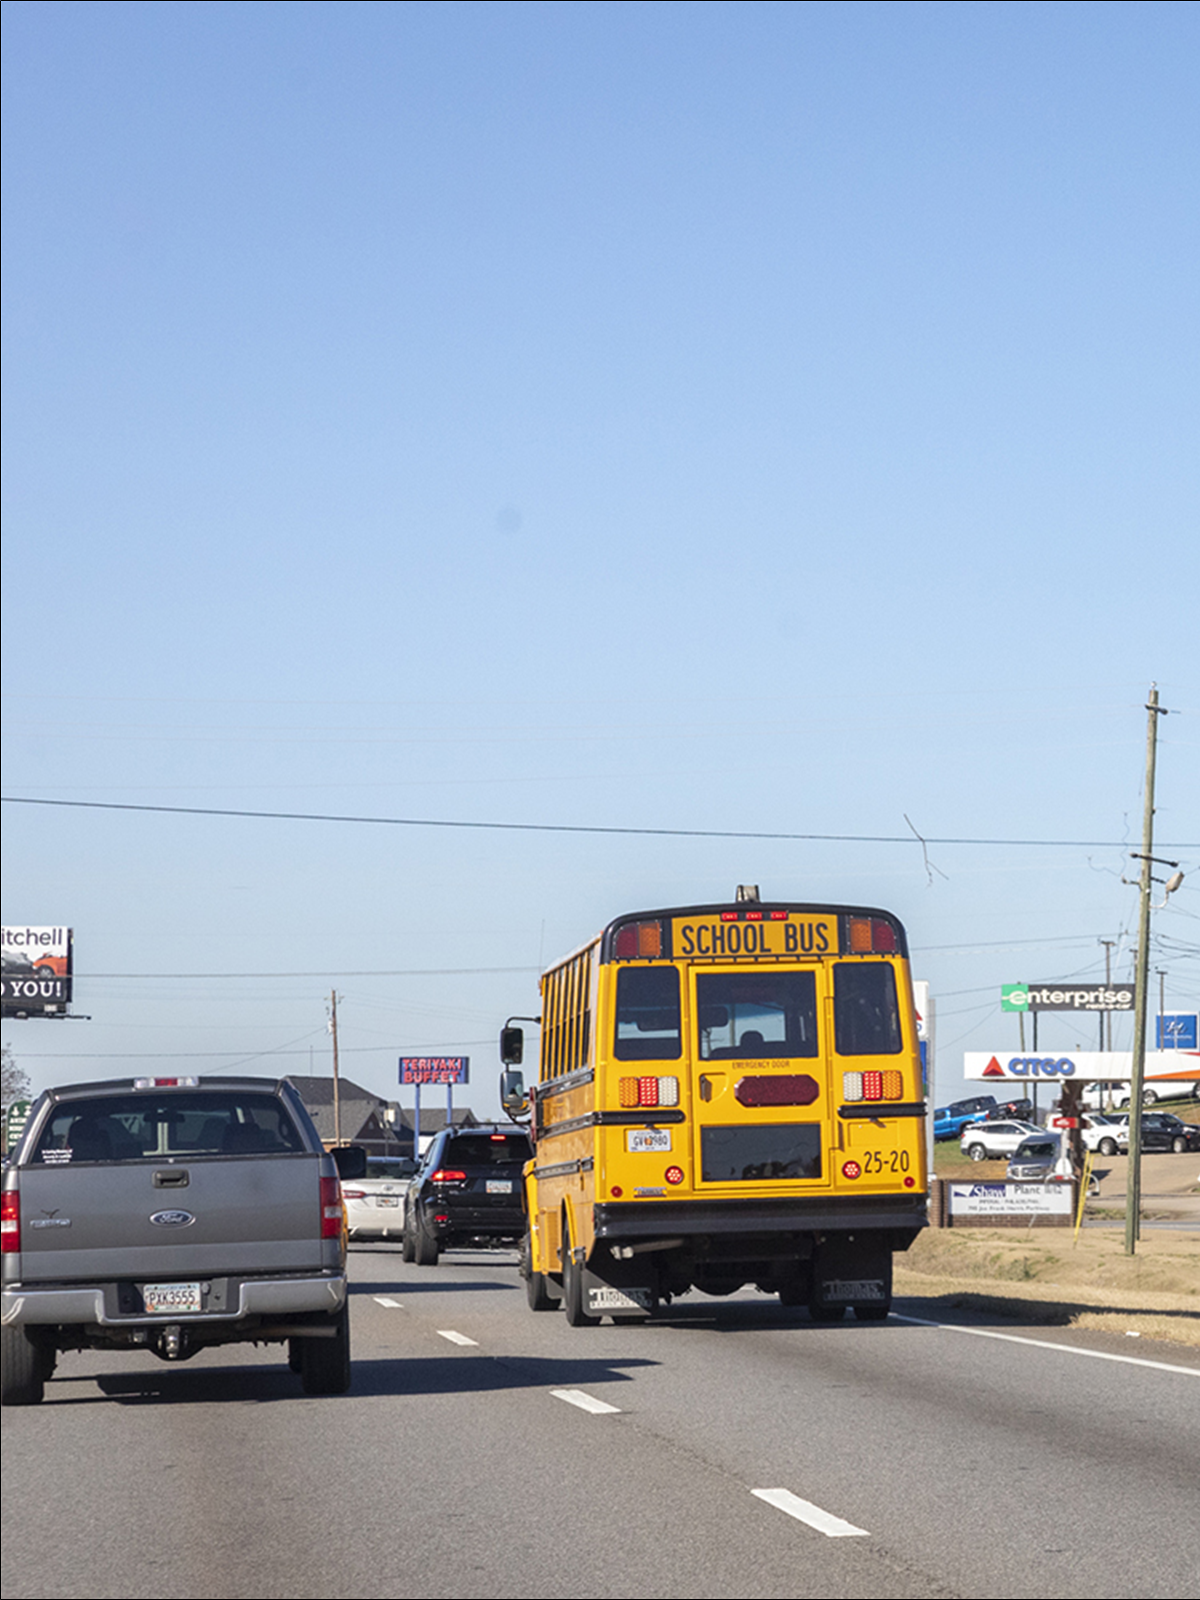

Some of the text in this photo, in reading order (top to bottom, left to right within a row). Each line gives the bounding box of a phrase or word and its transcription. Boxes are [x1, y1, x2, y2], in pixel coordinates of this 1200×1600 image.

[681, 922, 829, 955] SCHOOL BUS
[10, 981, 62, 997] YOU!
[1008, 987, 1132, 1007] enterprise
[402, 1058, 462, 1070] TERIYAKI
[732, 1059, 790, 1070] EMERGENCY DOOR
[1008, 1057, 1076, 1077] CITGO
[404, 1071, 459, 1083] BUFFET
[864, 1150, 909, 1174] 25-20
[973, 1184, 1007, 1198] Shaw
[1014, 1183, 1041, 1195] Plant
[159, 1212, 184, 1225] Ford
[149, 1290, 196, 1306] PXK3555
